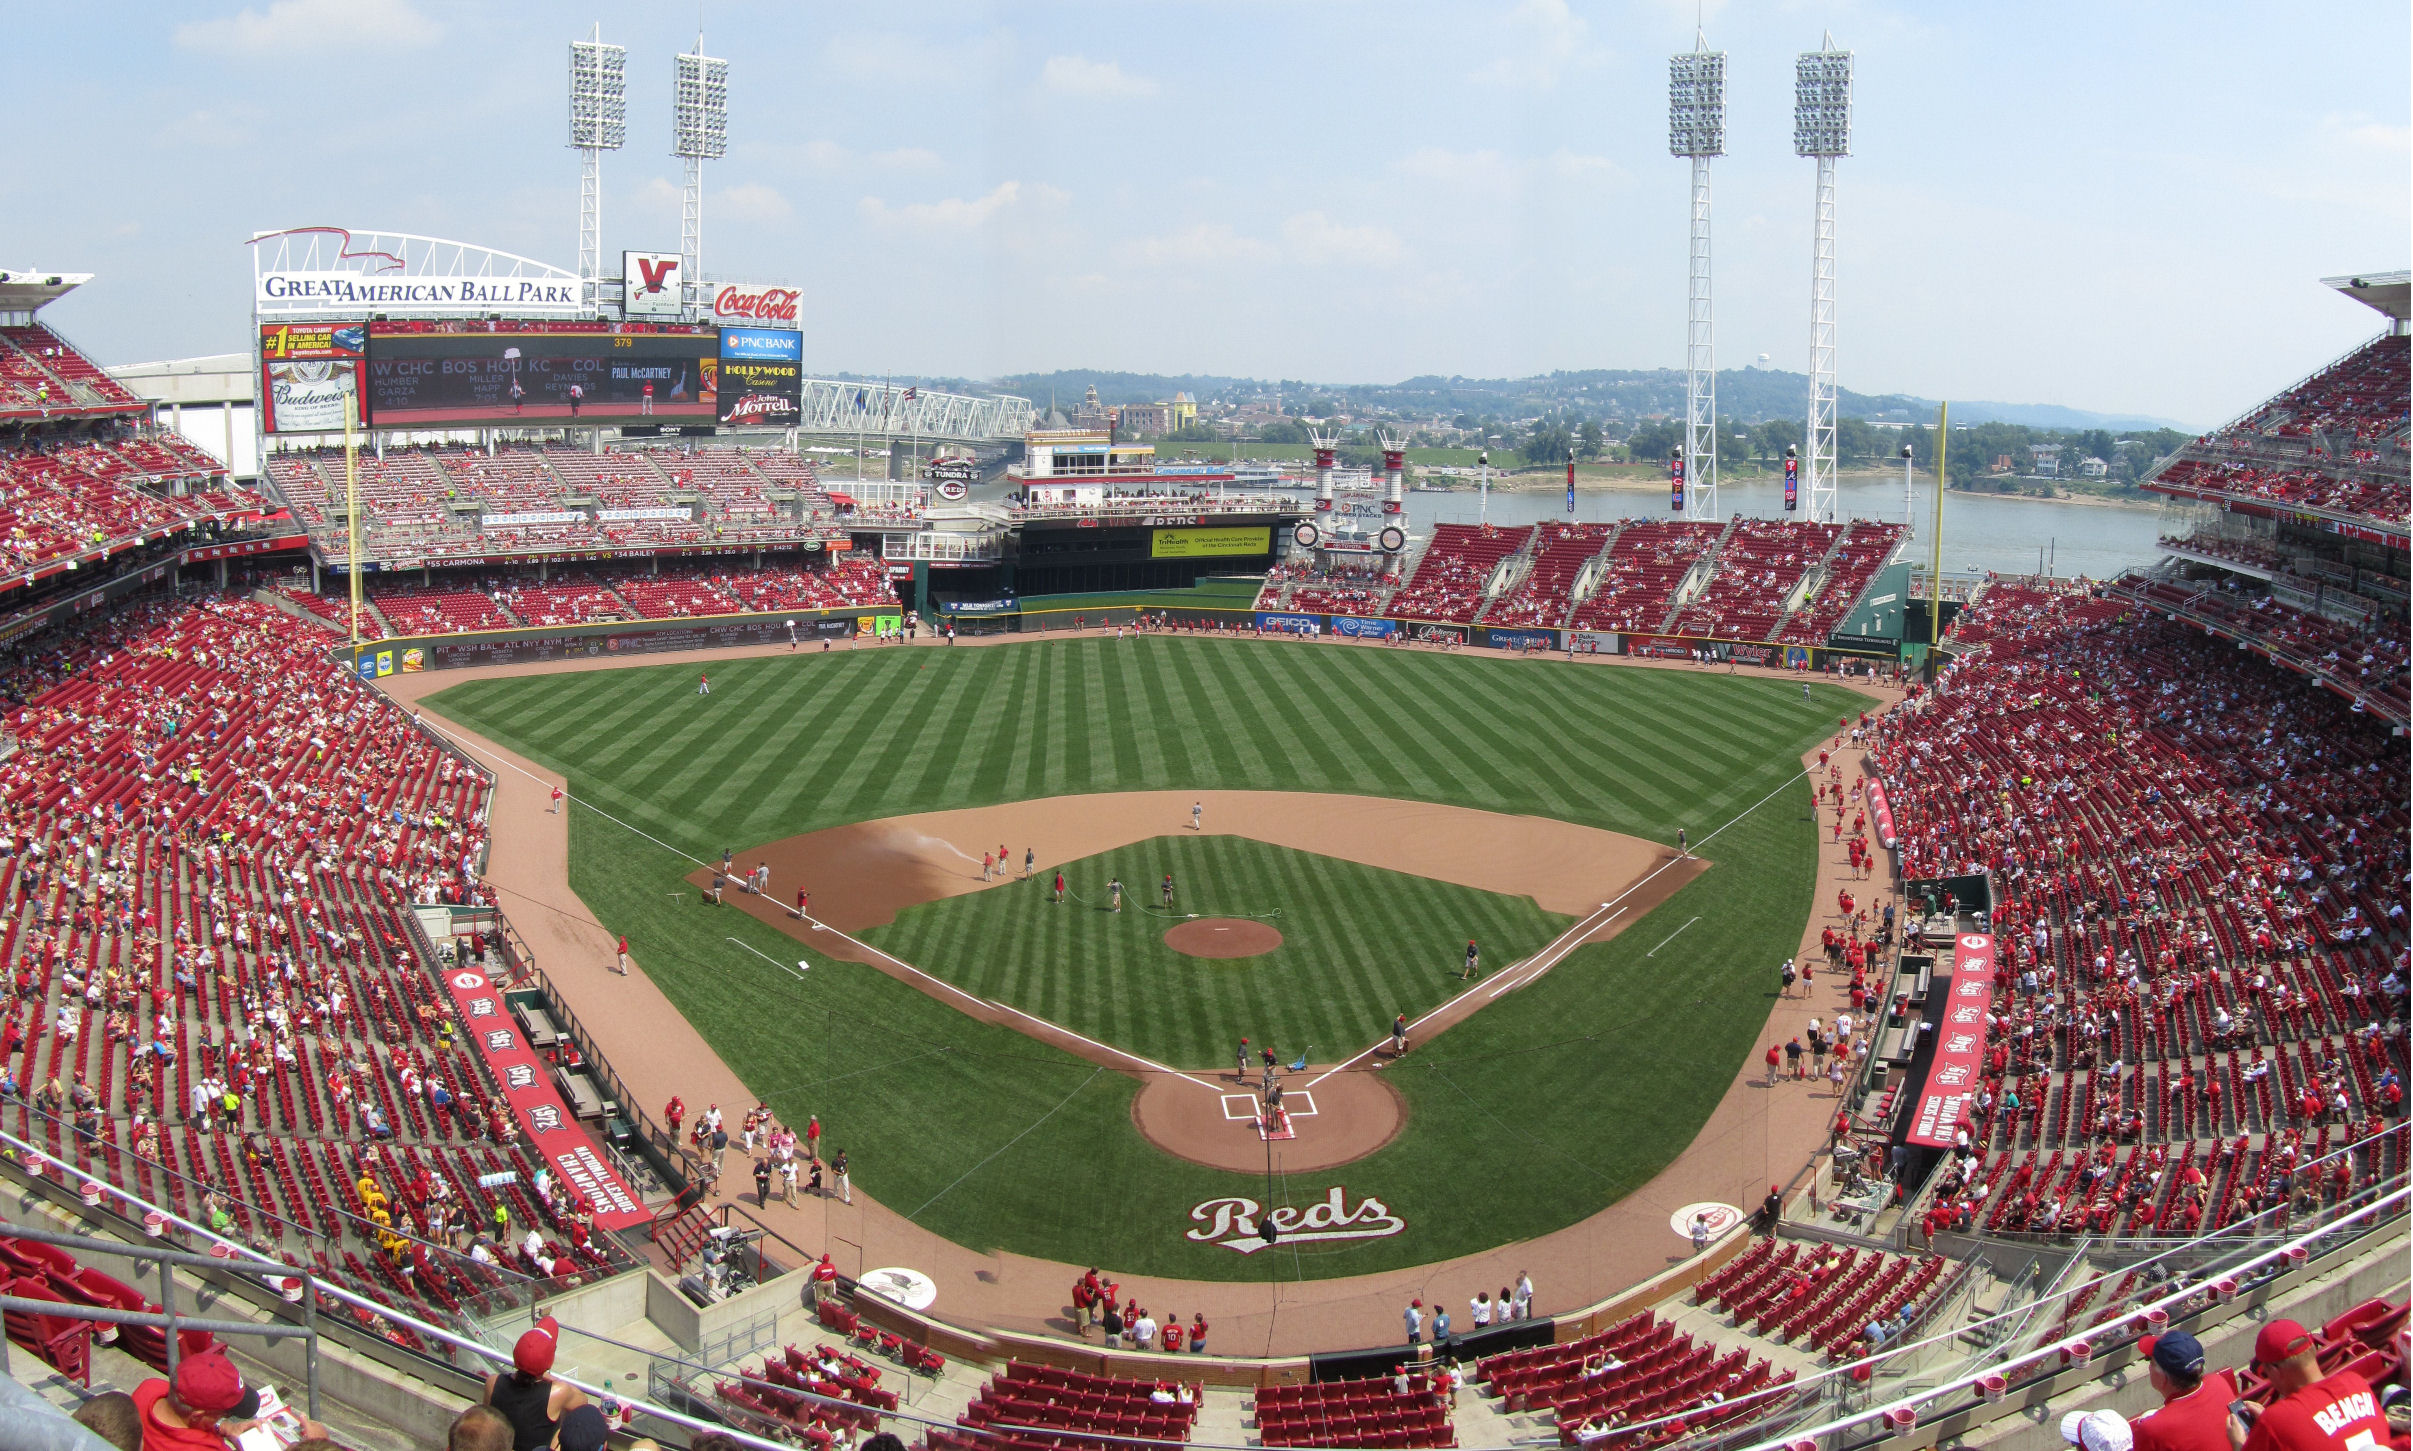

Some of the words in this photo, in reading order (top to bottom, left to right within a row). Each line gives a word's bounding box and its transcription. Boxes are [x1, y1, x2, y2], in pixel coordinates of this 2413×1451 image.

[265, 276, 349, 299] GREAT
[338, 281, 456, 302] AMERICAN
[459, 281, 514, 302] BALL
[518, 282, 575, 302] PARK
[714, 285, 803, 321] Coca-Cola
[287, 334, 316, 342] SELLING
[317, 333, 332, 341] CAR
[614, 338, 632, 348] 379
[741, 336, 764, 348] PNC
[765, 338, 796, 350] BANK
[296, 341, 331, 349] AMERICA!
[397, 362, 434, 375] CHC
[442, 361, 478, 374] BOS
[487, 360, 522, 373] HOU
[529, 360, 551, 373] KC
[573, 359, 604, 372] COL
[725, 365, 796, 377] HOLLYWOOD
[469, 374, 504, 383] MILLER
[553, 373, 588, 381] DAVIES
[612, 367, 630, 379] PAUL
[631, 367, 671, 379] McCARTNEY
[374, 376, 419, 386] HUMBER
[743, 374, 778, 387] Casino
[378, 387, 416, 396] GARZA
[474, 385, 500, 393] HAPP
[757, 394, 778, 403] John
[720, 398, 799, 422] Morrell
[934, 471, 968, 479] TUNDRA
[1206, 466, 1225, 474] Bell
[945, 486, 967, 494] REDS
[1352, 504, 1376, 514] PNC
[602, 552, 612, 560] VS
[442, 558, 485, 568] CARMONA
[888, 566, 910, 574] SPARKY
[1265, 616, 1311, 627] GEICO
[709, 626, 728, 634] CHW
[728, 624, 744, 633] CHC
[746, 623, 762, 631] BOS
[437, 646, 450, 654] PIT
[458, 644, 478, 653] WSH
[480, 643, 497, 651] BAL
[504, 642, 520, 650] ATL
[523, 640, 540, 648] NYY
[543, 638, 562, 646] NYM
[1732, 643, 1773, 660] Wyler
[403, 651, 424, 664] Kahn's
[508, 1064, 532, 1087] 1970
[536, 1104, 559, 1131] 1972
[1916, 1114, 1937, 1137] WORLD
[556, 1153, 616, 1214] CHAMPIONS
[573, 1145, 612, 1183] NATIONAL
[602, 1181, 638, 1214] LEAGUE
[1183, 1185, 1408, 1256] Reds
[1167, 1333, 1177, 1341] 10
[2312, 1391, 2376, 1437] BENCH
